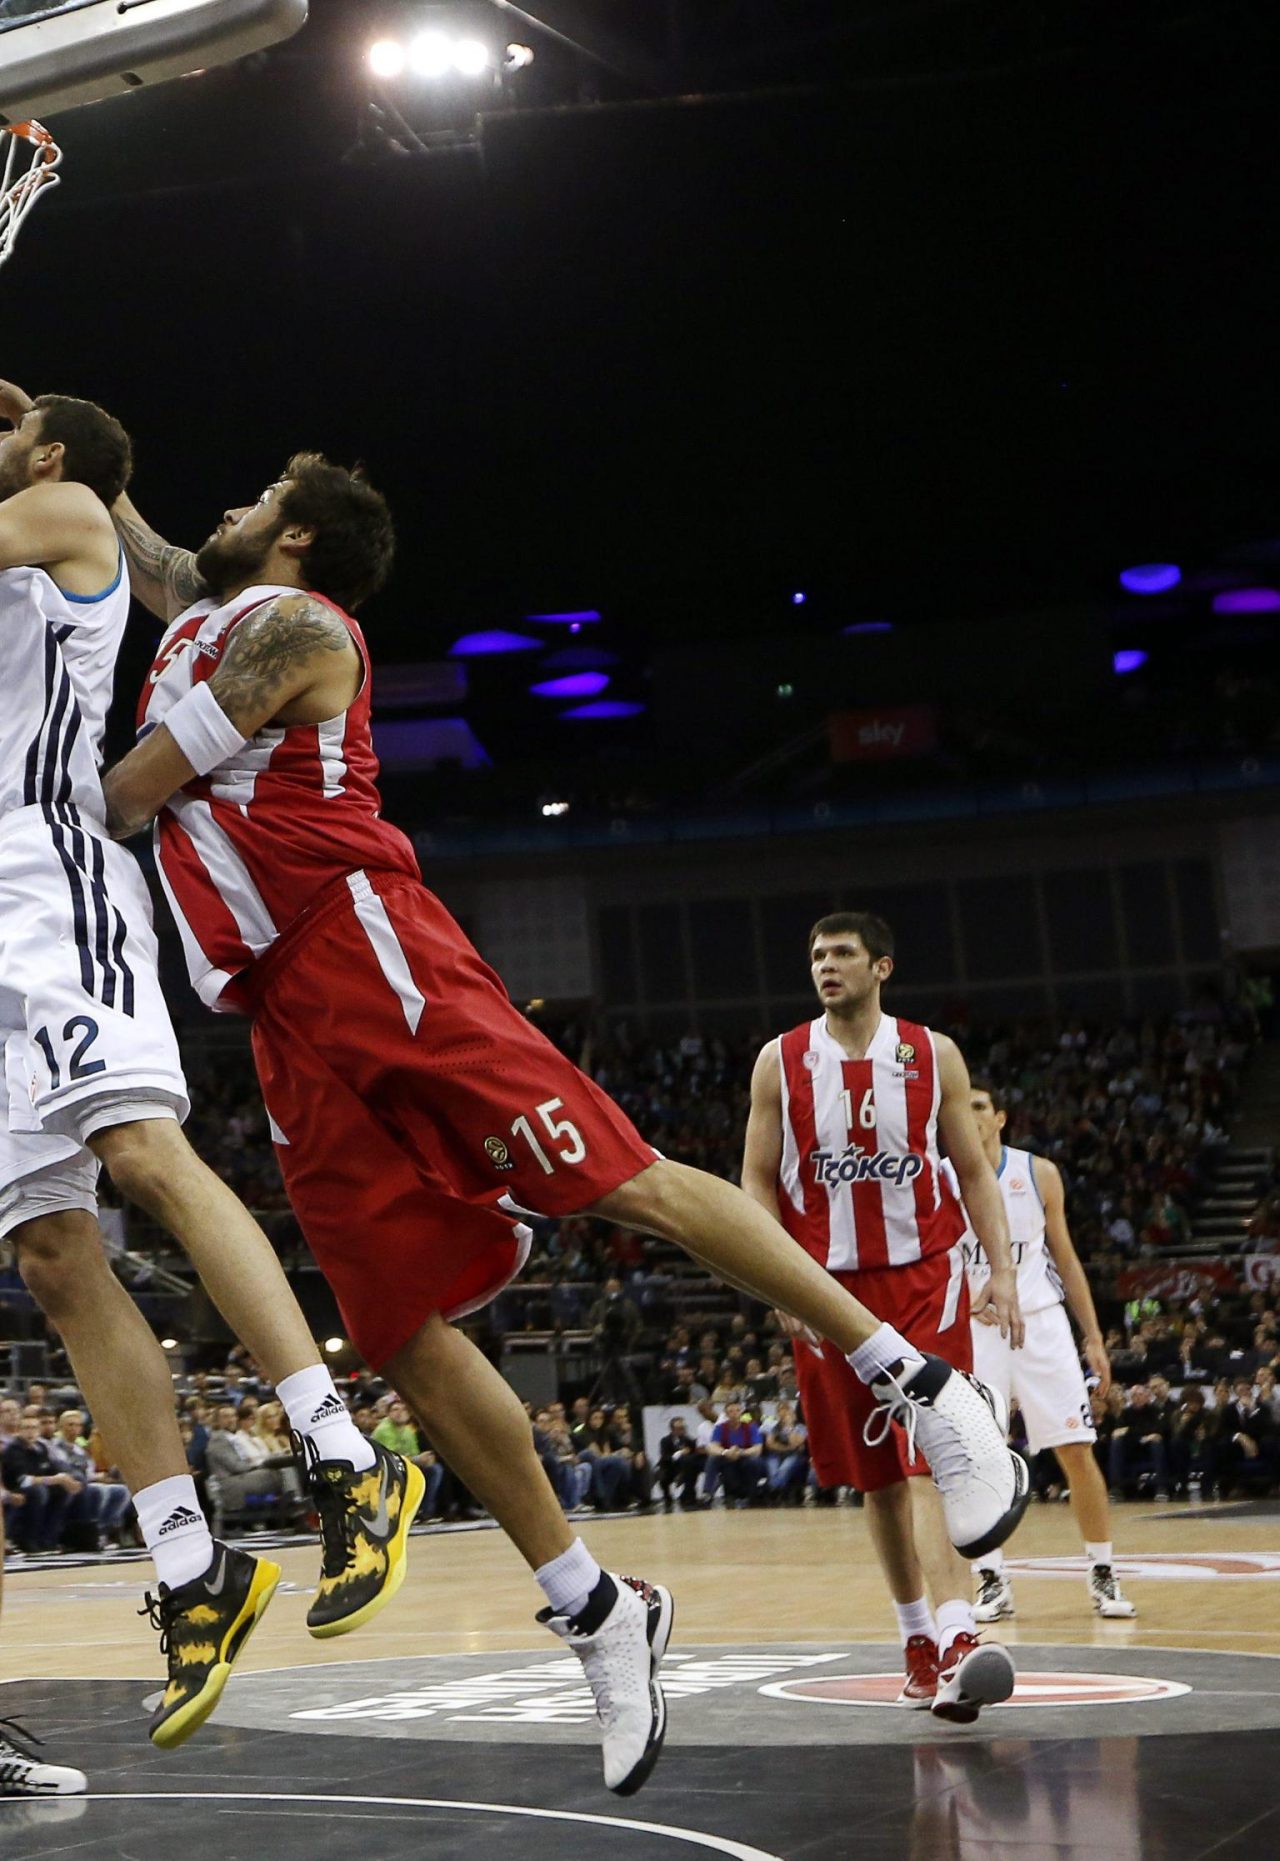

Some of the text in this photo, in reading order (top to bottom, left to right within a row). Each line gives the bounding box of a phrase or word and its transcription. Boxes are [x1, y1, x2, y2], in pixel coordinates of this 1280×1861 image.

[858, 719, 906, 749] sky
[34, 1015, 107, 1090] 12
[838, 1088, 877, 1130] 16
[510, 1097, 587, 1175] 15
[958, 1240, 1030, 1266] MT
[310, 1405, 348, 1424] adida
[158, 1514, 203, 1537] adidas
